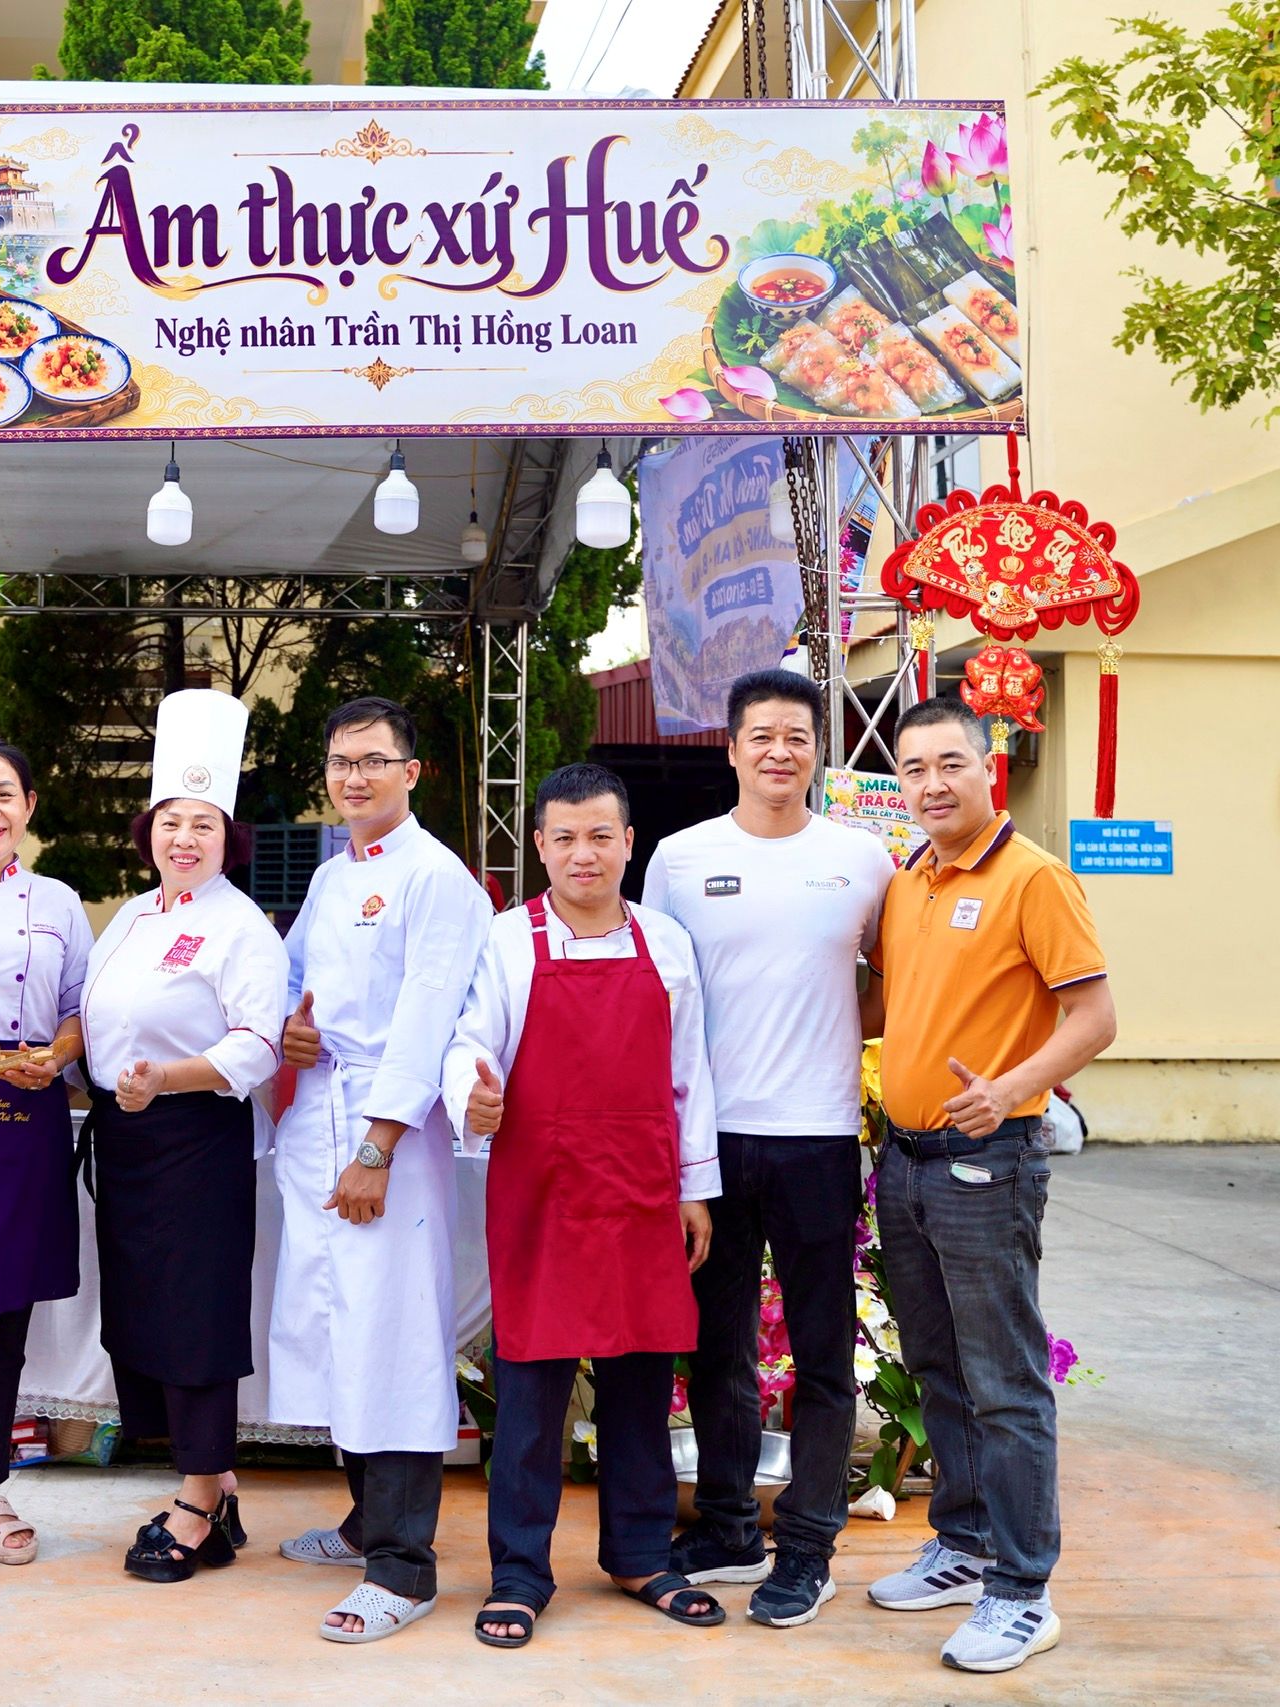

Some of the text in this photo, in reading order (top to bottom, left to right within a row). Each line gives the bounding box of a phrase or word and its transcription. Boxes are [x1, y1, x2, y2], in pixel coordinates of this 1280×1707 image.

[47, 124, 730, 296] Ẩm thực xứ Huế
[155, 303, 638, 355] Nghệ nhân Trần Thị Hồng Loan
[856, 792, 884, 807] TRÀ
[865, 779, 901, 794] MEN
